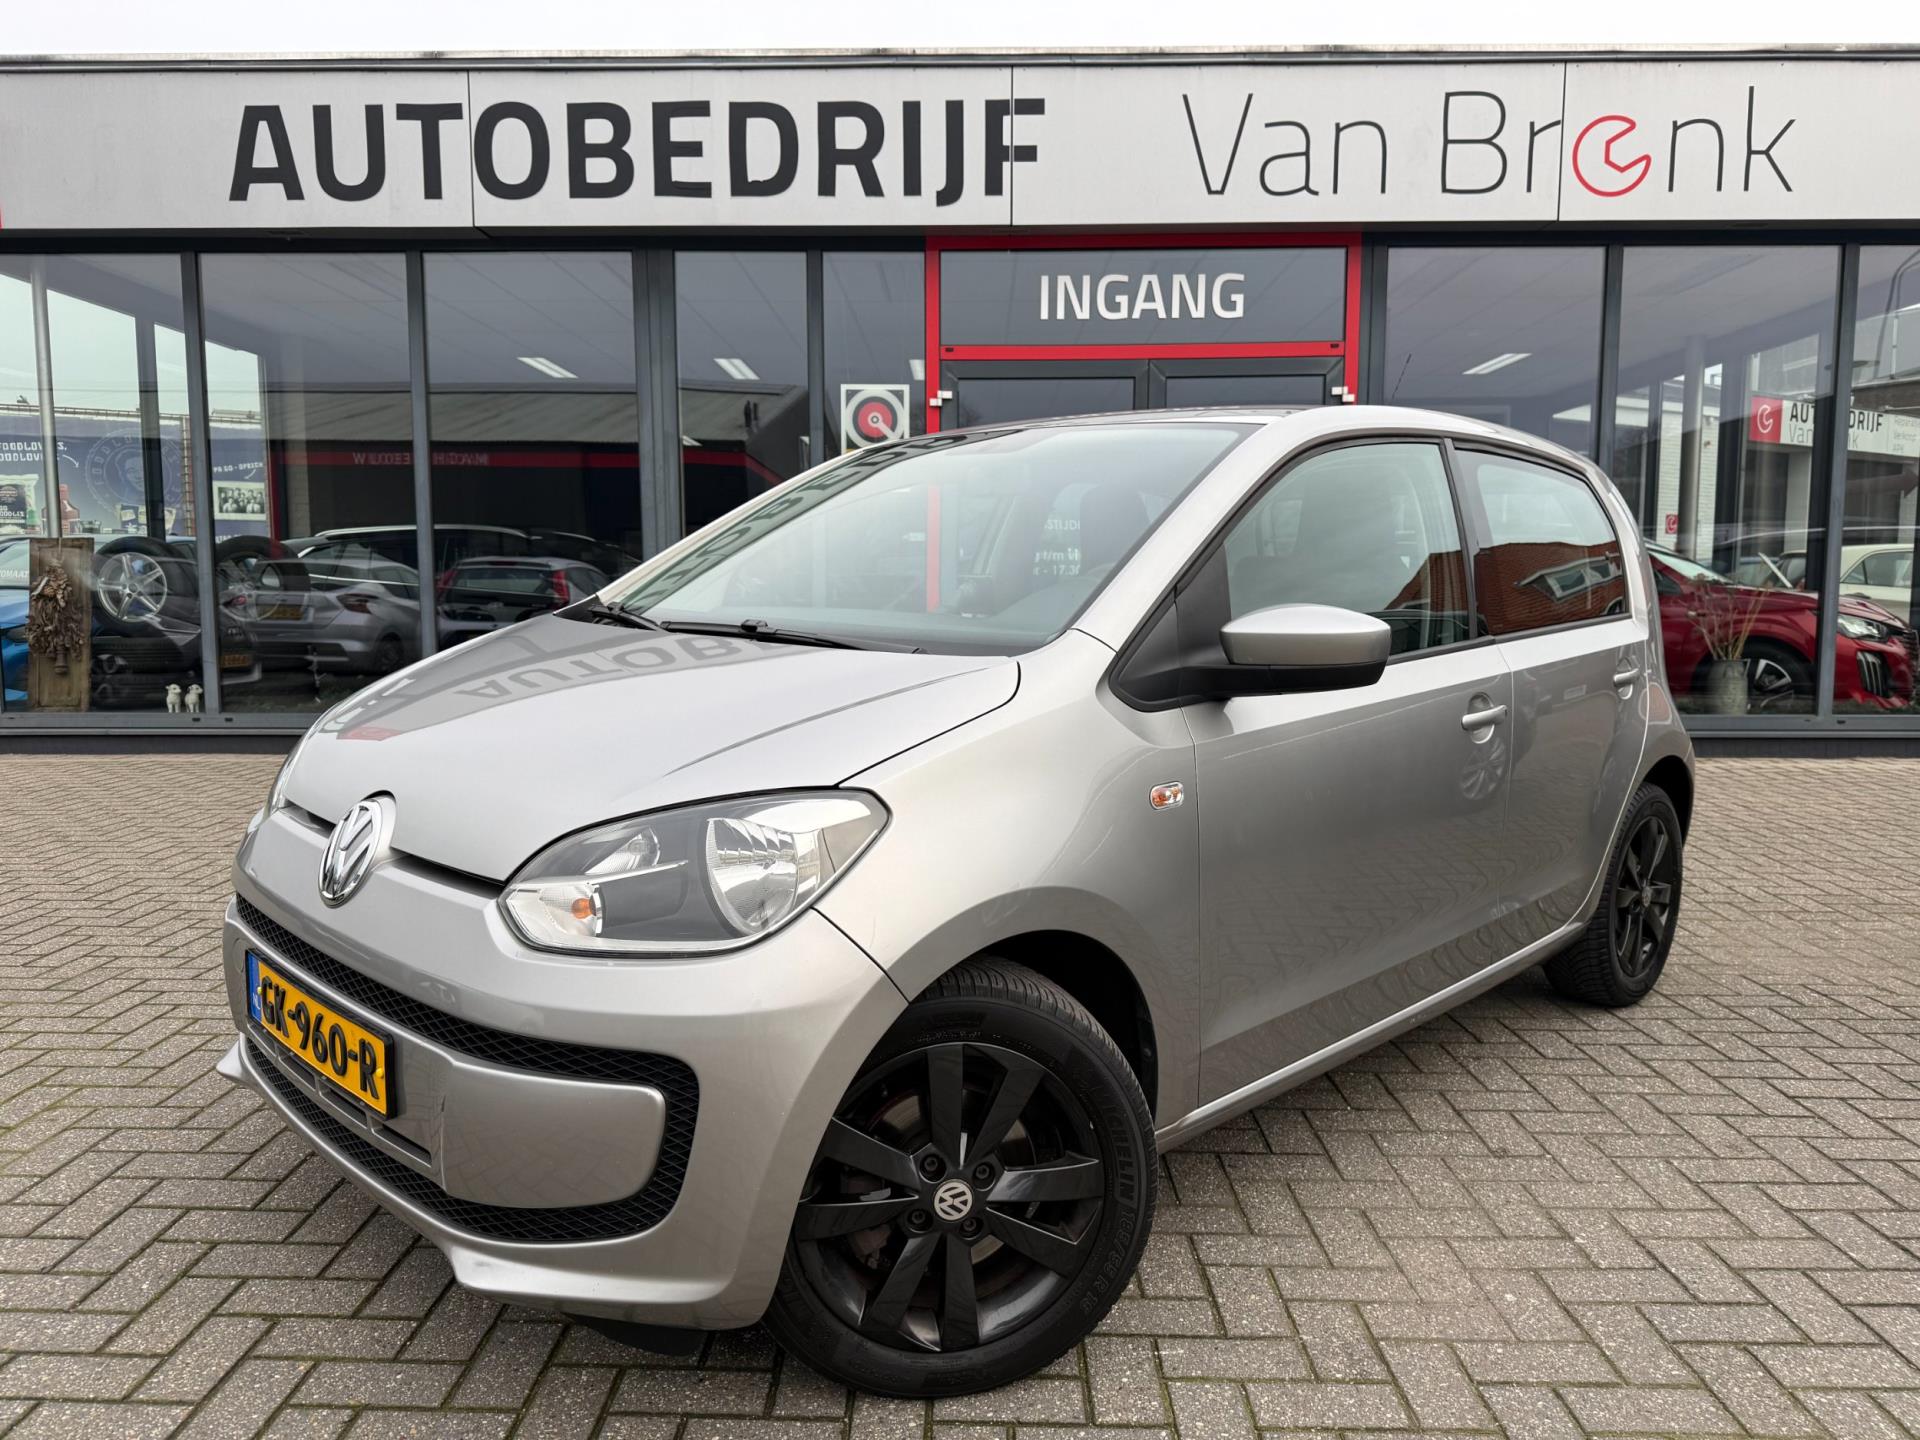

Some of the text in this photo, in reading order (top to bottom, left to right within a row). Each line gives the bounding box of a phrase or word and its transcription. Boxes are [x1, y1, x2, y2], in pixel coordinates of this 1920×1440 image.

[229, 98, 1046, 207] AUTOBEDRIJF
[1181, 92, 1320, 197] Van
[1038, 273, 1246, 320] INGANG
[261, 975, 380, 1101] GK-960-R
